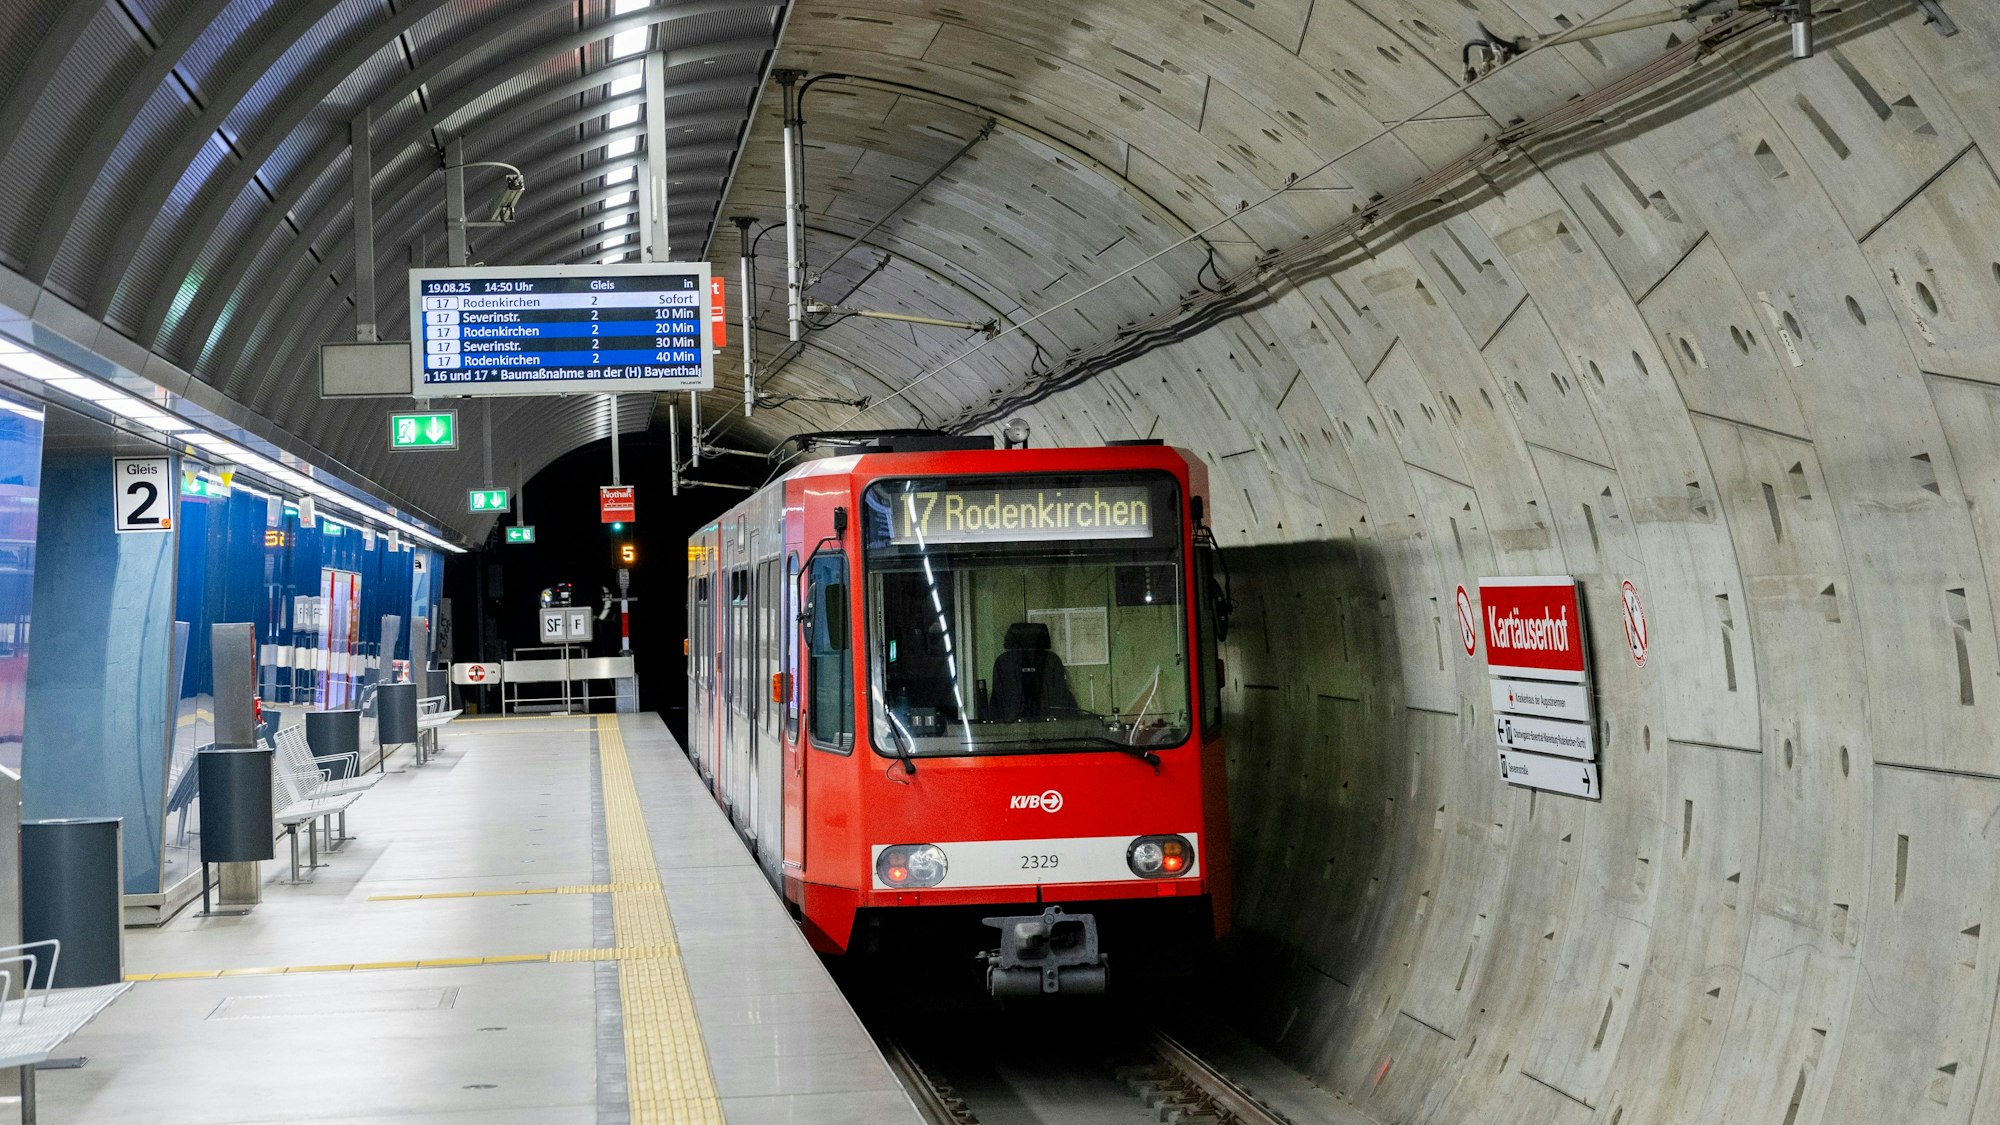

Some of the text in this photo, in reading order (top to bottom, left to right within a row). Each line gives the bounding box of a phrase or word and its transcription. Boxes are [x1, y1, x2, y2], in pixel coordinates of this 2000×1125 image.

[428, 282, 534, 293] 19.08.25 14:50 Uhr
[590, 280, 615, 290] Gleis
[684, 279, 693, 288] in
[436, 297, 540, 308] 17 Rodenkirchen
[592, 296, 598, 305] 2
[659, 294, 693, 304] Sofort
[437, 312, 521, 323] 17 Severinstr.
[591, 310, 599, 320] 2
[655, 308, 694, 319] 10 Min
[437, 326, 540, 337] 17 Rodenkirchen
[592, 324, 599, 335] 2
[655, 322, 694, 333] 20 Min
[437, 341, 521, 352] 17 Severinstr.
[592, 339, 599, 349] 2
[656, 337, 694, 348] 30 Min
[438, 355, 541, 366] 17 Rodenkirchen
[592, 353, 600, 364] 2
[656, 351, 695, 362] 40 Min
[433, 371, 447, 381] 16
[450, 370, 471, 381] und
[474, 370, 488, 380] 17
[501, 367, 584, 380] Baumaßnahme
[587, 369, 601, 378] an
[603, 367, 622, 378] der
[625, 366, 641, 379] (H)
[127, 463, 158, 475] Gleis
[127, 481, 159, 525] 2
[900, 491, 1148, 537] 17 Rodenkirchen
[622, 546, 634, 561] 5
[546, 617, 561, 633] SF
[575, 619, 582, 630] F
[1487, 605, 1569, 652] Kartäuserhof
[1010, 795, 1040, 809] KVB
[1021, 854, 1059, 870] 2329
